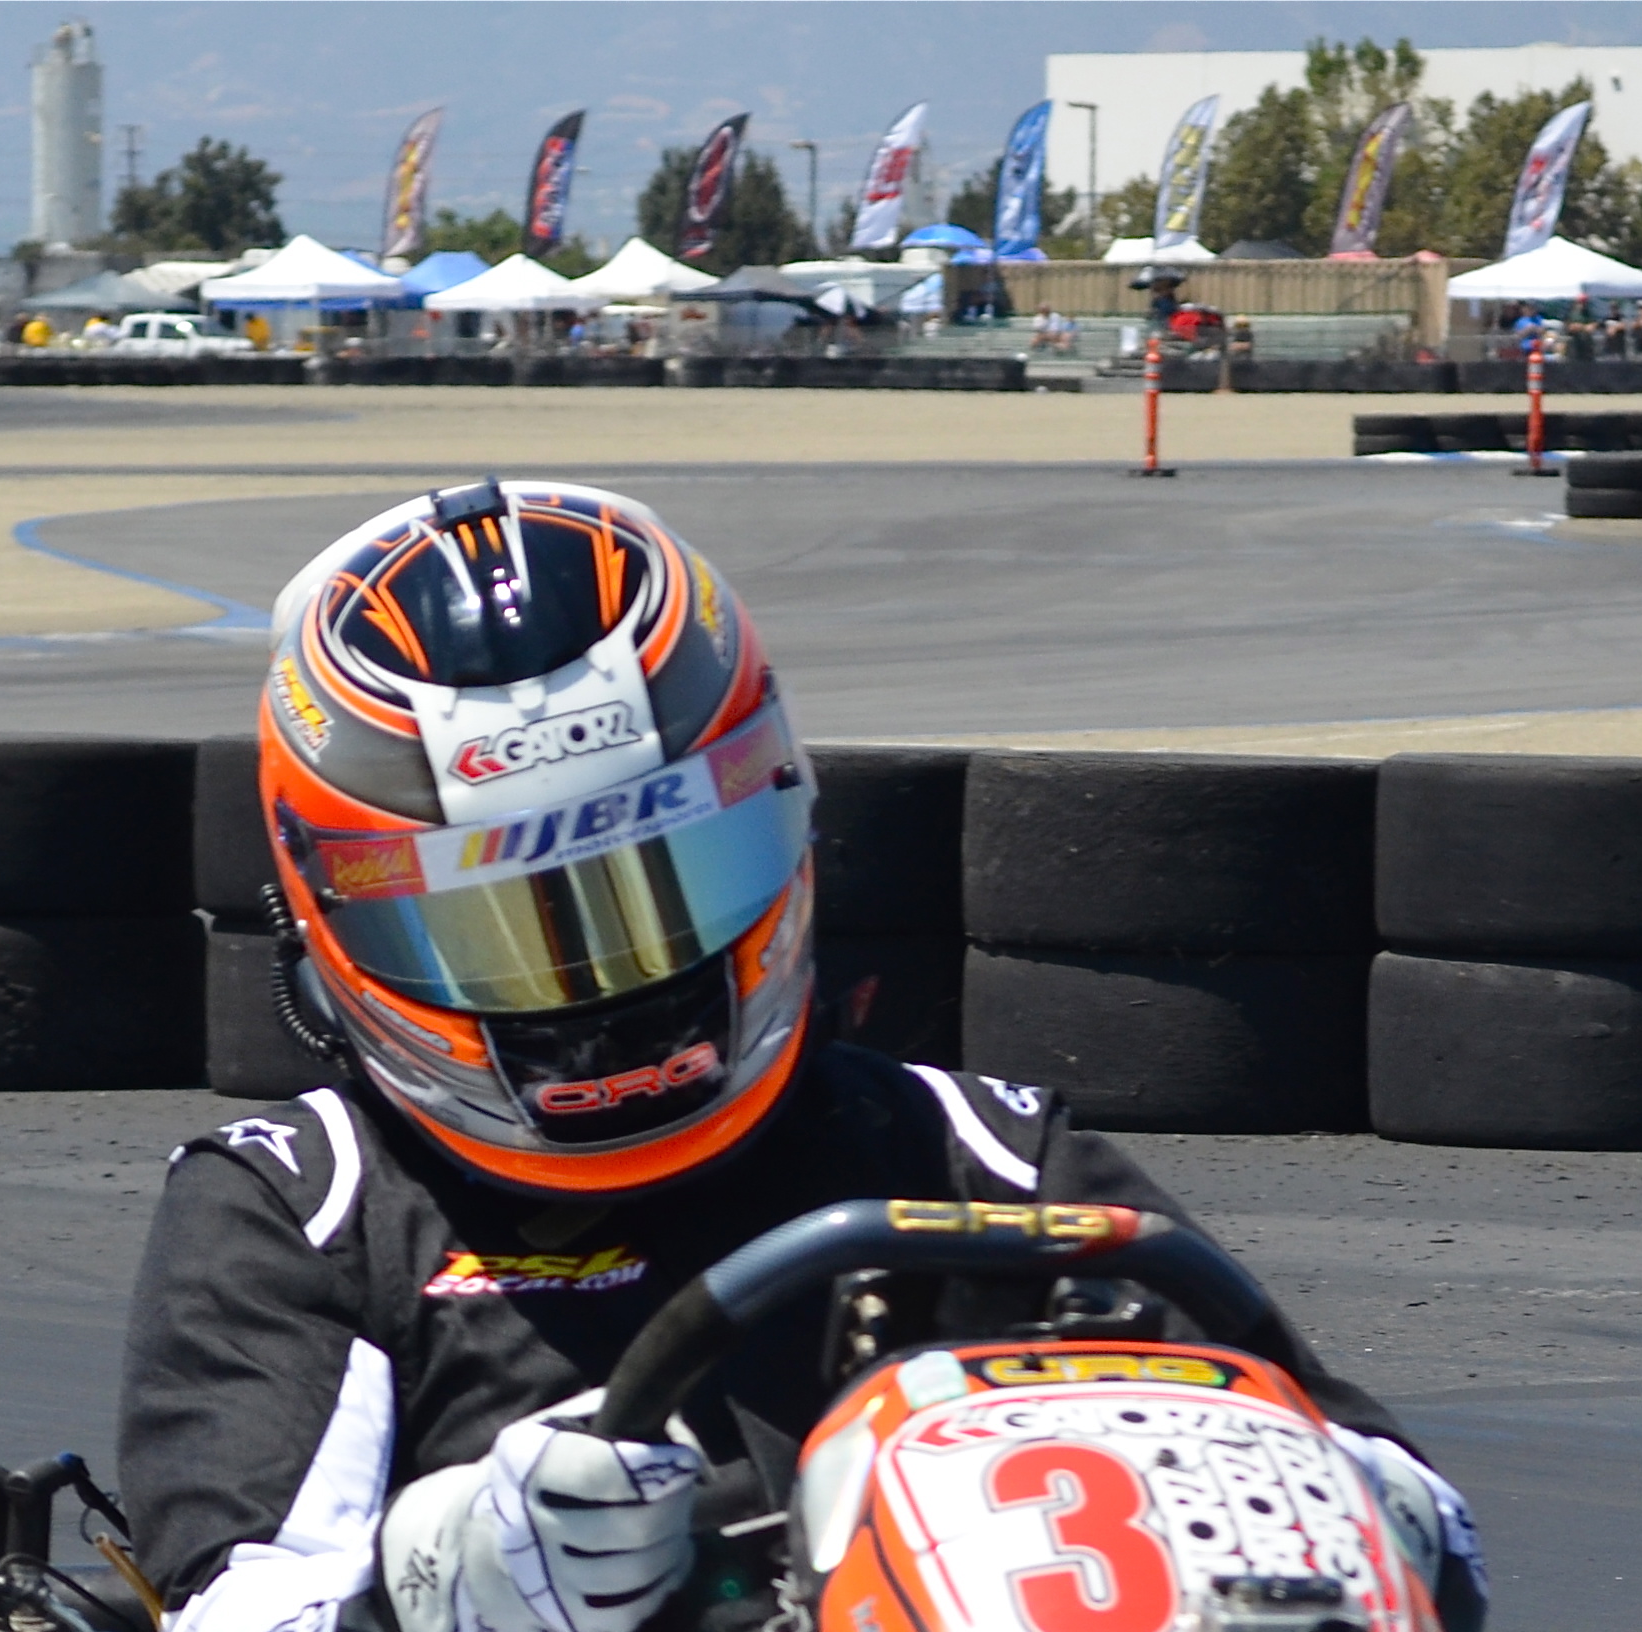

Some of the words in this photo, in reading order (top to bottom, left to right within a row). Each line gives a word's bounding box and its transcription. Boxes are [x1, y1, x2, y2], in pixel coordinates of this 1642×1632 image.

[493, 702, 643, 765] GATORZ
[523, 772, 691, 863] JBR
[536, 1041, 718, 1114] CRG
[887, 1199, 1111, 1238] CRG
[447, 1246, 631, 1279] PSL
[982, 1353, 1225, 1386] CRG
